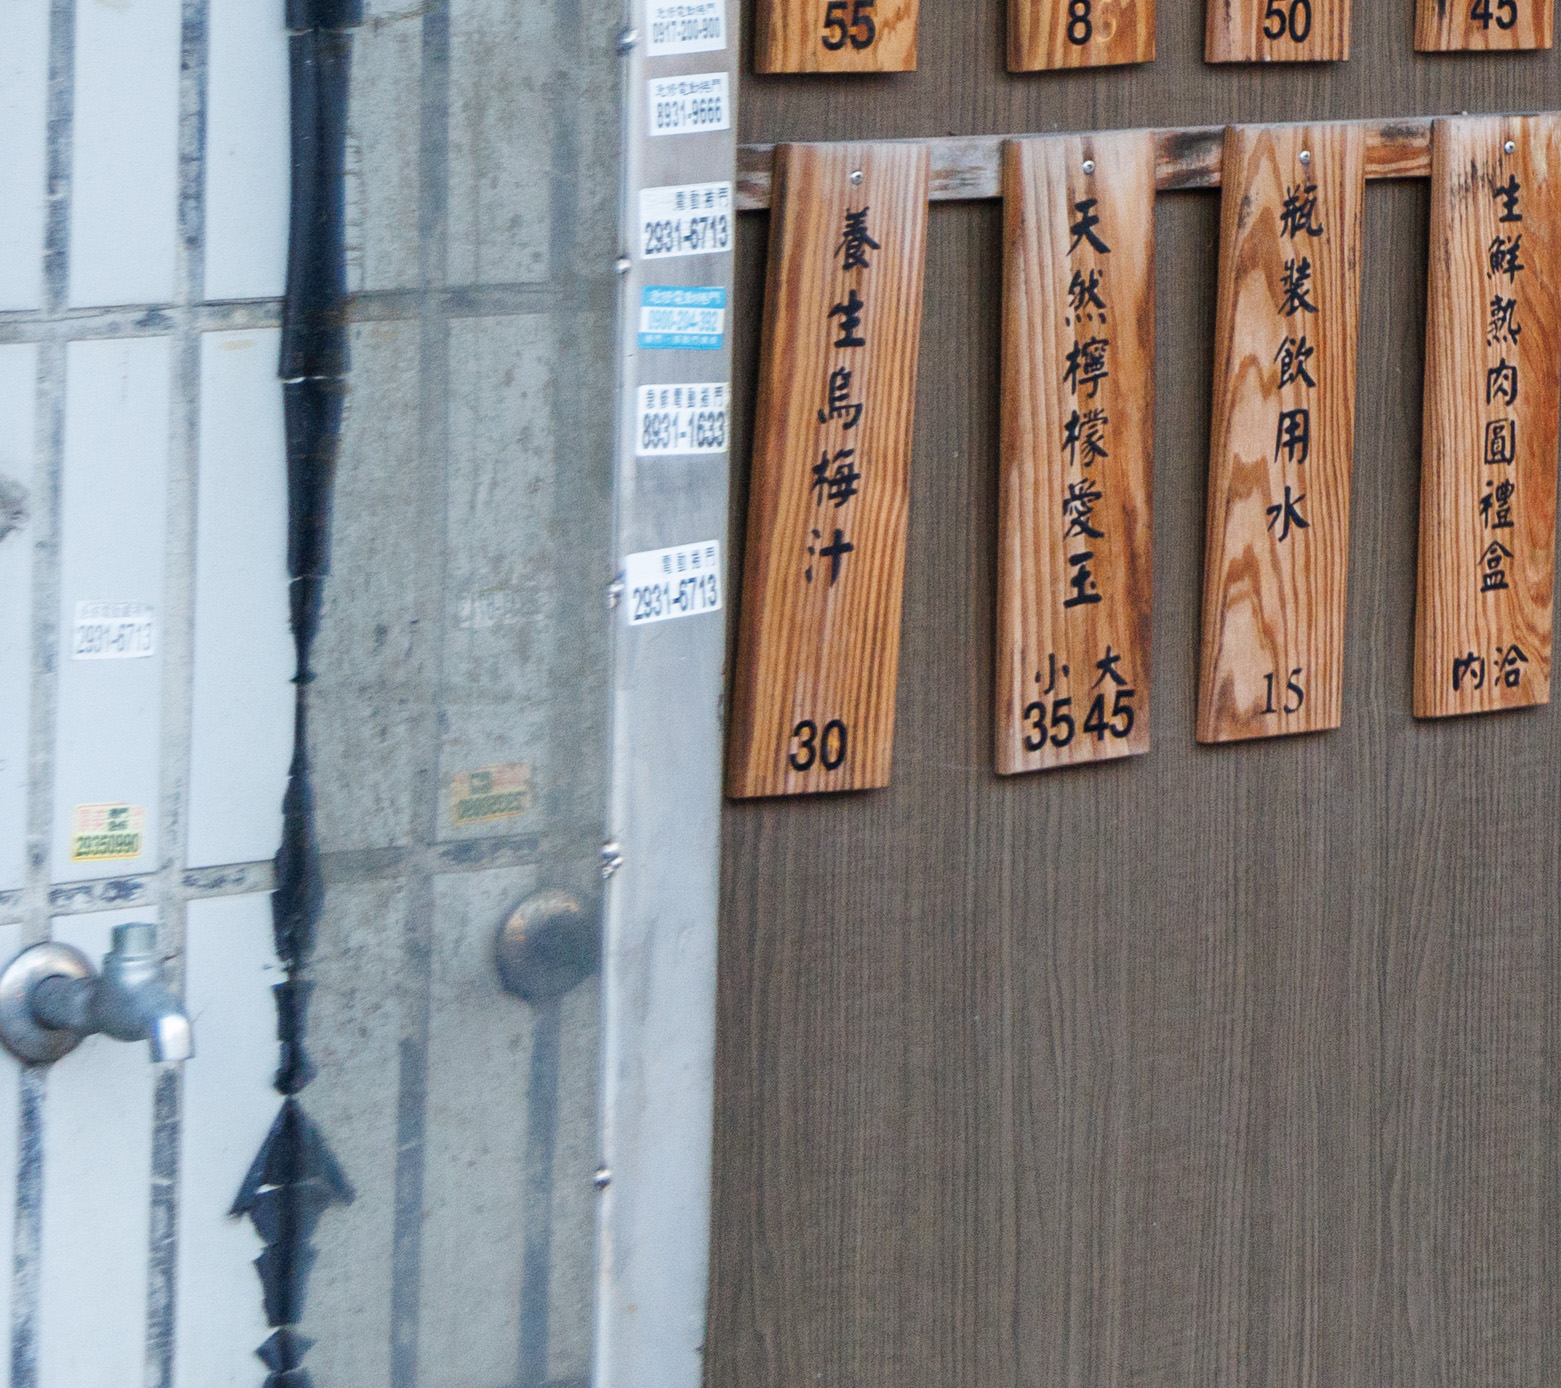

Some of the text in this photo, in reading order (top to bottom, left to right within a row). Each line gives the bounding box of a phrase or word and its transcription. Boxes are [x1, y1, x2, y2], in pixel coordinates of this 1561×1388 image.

[656, 96, 722, 128] 8931-9666
[644, 214, 729, 255] 2931-6713
[1266, 184, 1324, 542] 瓶裝飲用水
[804, 206, 880, 588] 養生烏梅汁
[1061, 197, 1110, 609] 天然檸檬愛玉
[642, 411, 726, 450] 8931-1633
[632, 573, 719, 621] 2931-6713
[1034, 644, 1127, 695] 小 大
[1261, 667, 1305, 715] 15
[789, 719, 847, 772] 30
[1023, 689, 1135, 752] 35 45
